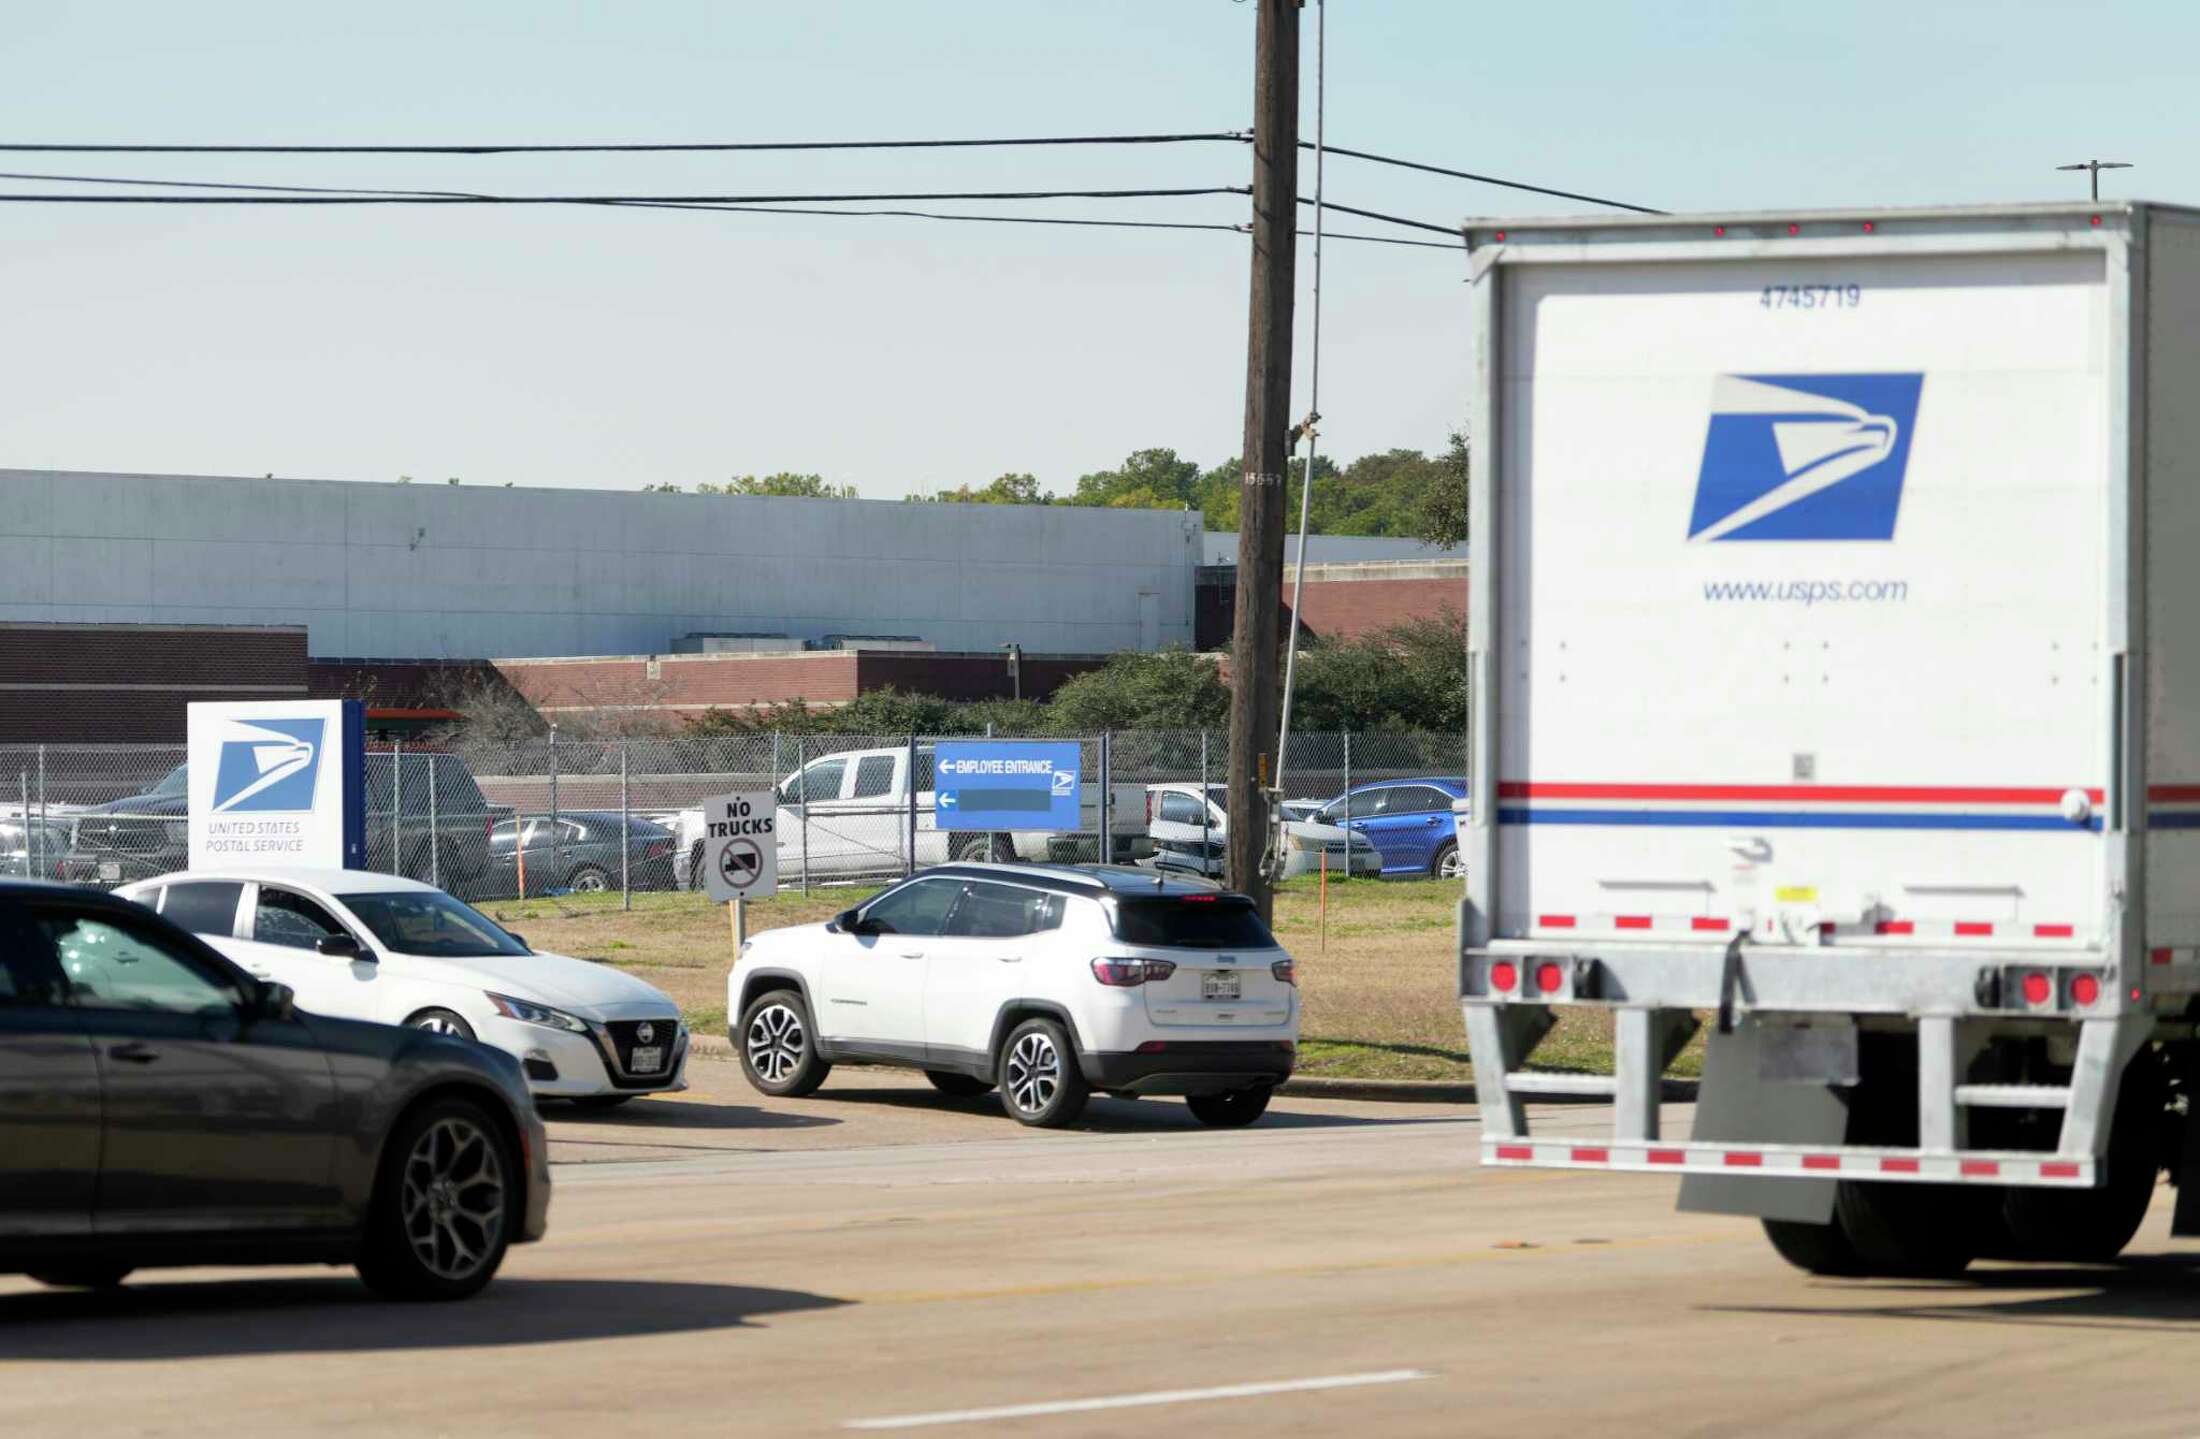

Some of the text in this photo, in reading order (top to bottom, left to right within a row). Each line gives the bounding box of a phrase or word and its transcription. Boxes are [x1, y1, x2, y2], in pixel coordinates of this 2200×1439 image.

[1759, 283, 1862, 308] 4745719
[1704, 580, 1909, 607] www.usps.com
[956, 759, 1054, 774] EMPLOYEE ENTRANCE
[727, 801, 751, 818] NO
[208, 821, 301, 834] UNITED STATES
[707, 817, 773, 838] TRUCKS
[206, 839, 304, 852] POSTAL SERVICE
